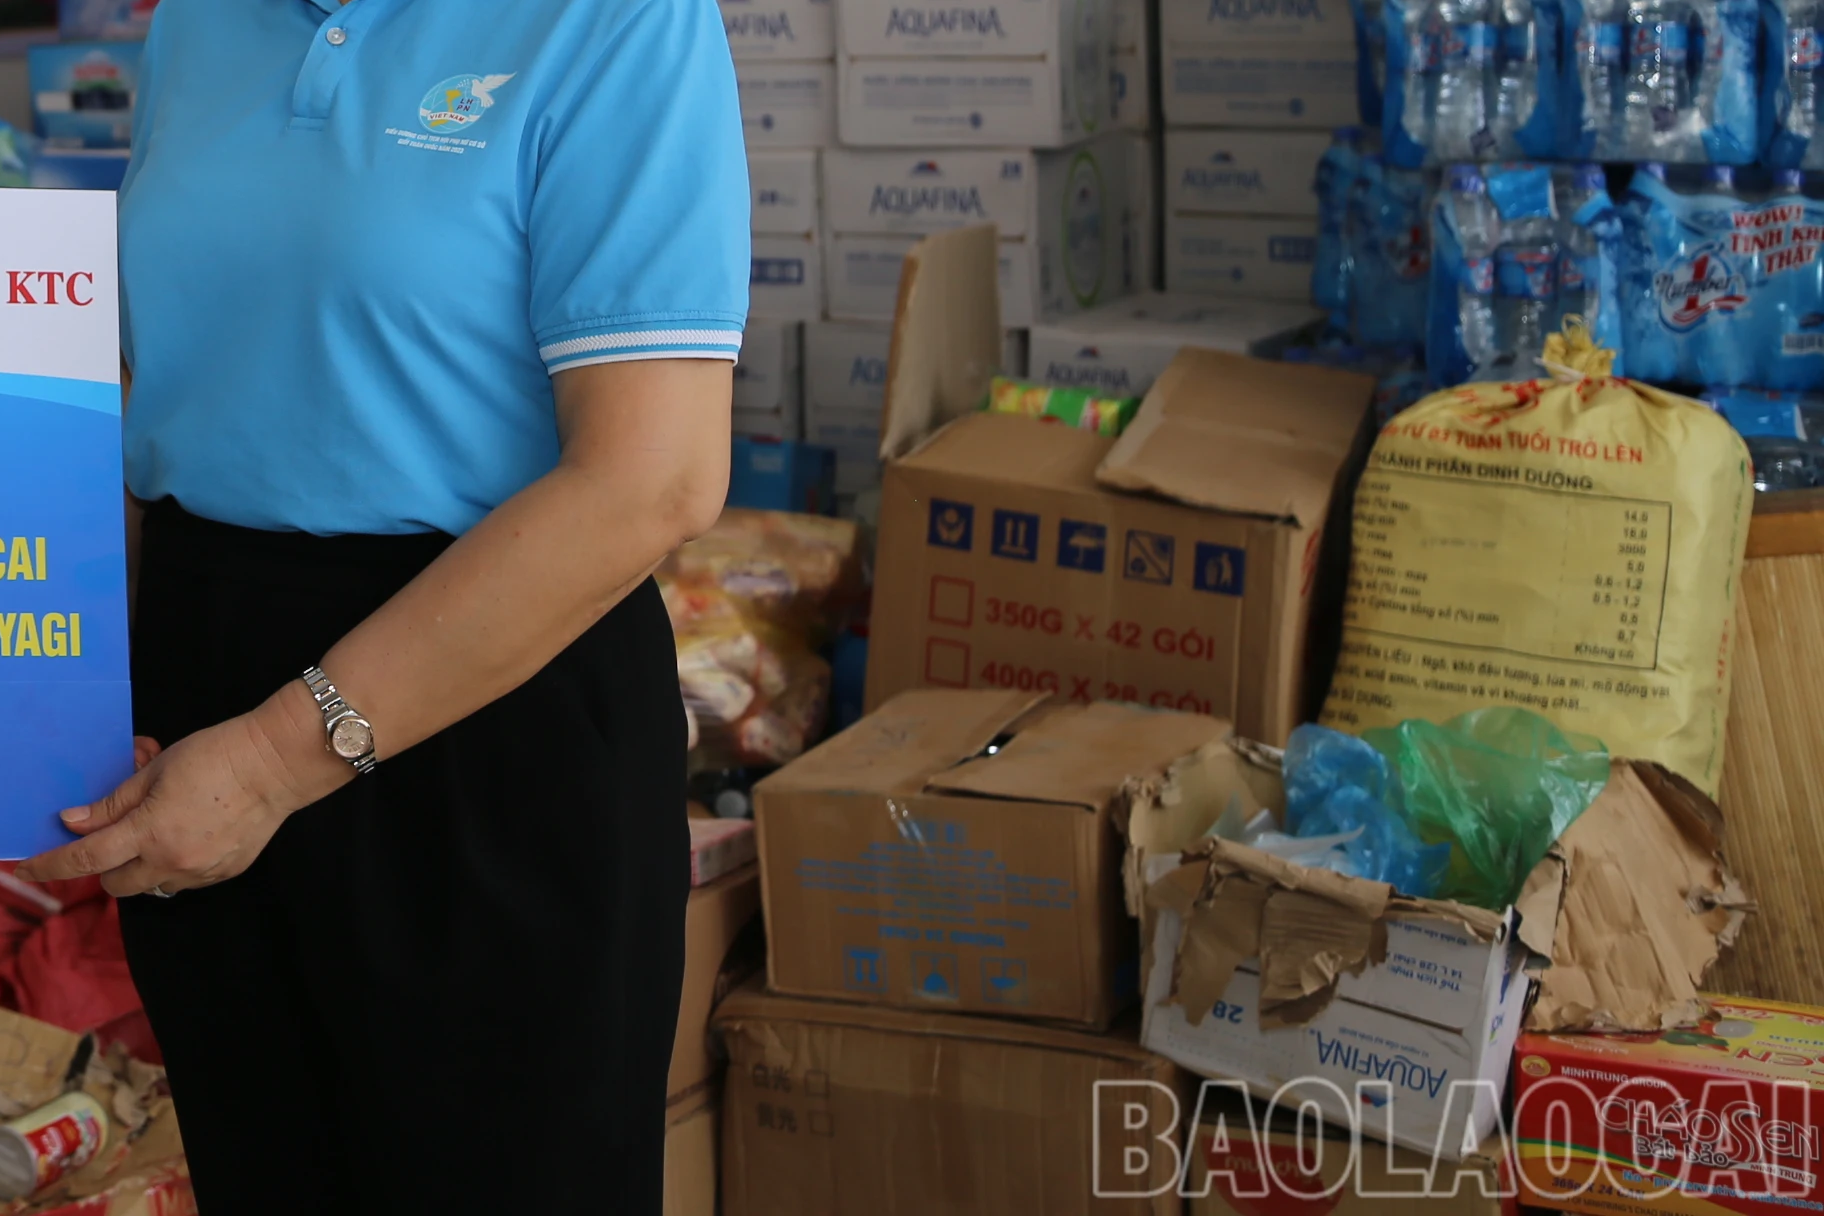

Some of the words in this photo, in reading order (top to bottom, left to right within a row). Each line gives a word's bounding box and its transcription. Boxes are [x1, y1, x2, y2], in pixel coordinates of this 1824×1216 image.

[884, 6, 1006, 40] AQUAFINA
[868, 184, 987, 218] AQUAFINA
[1729, 228, 1784, 254] TINH
[8, 270, 94, 307] KTC
[985, 597, 1063, 635] 350G
[1105, 620, 1142, 650] 42
[1316, 1030, 1448, 1099] AQUAFINA
